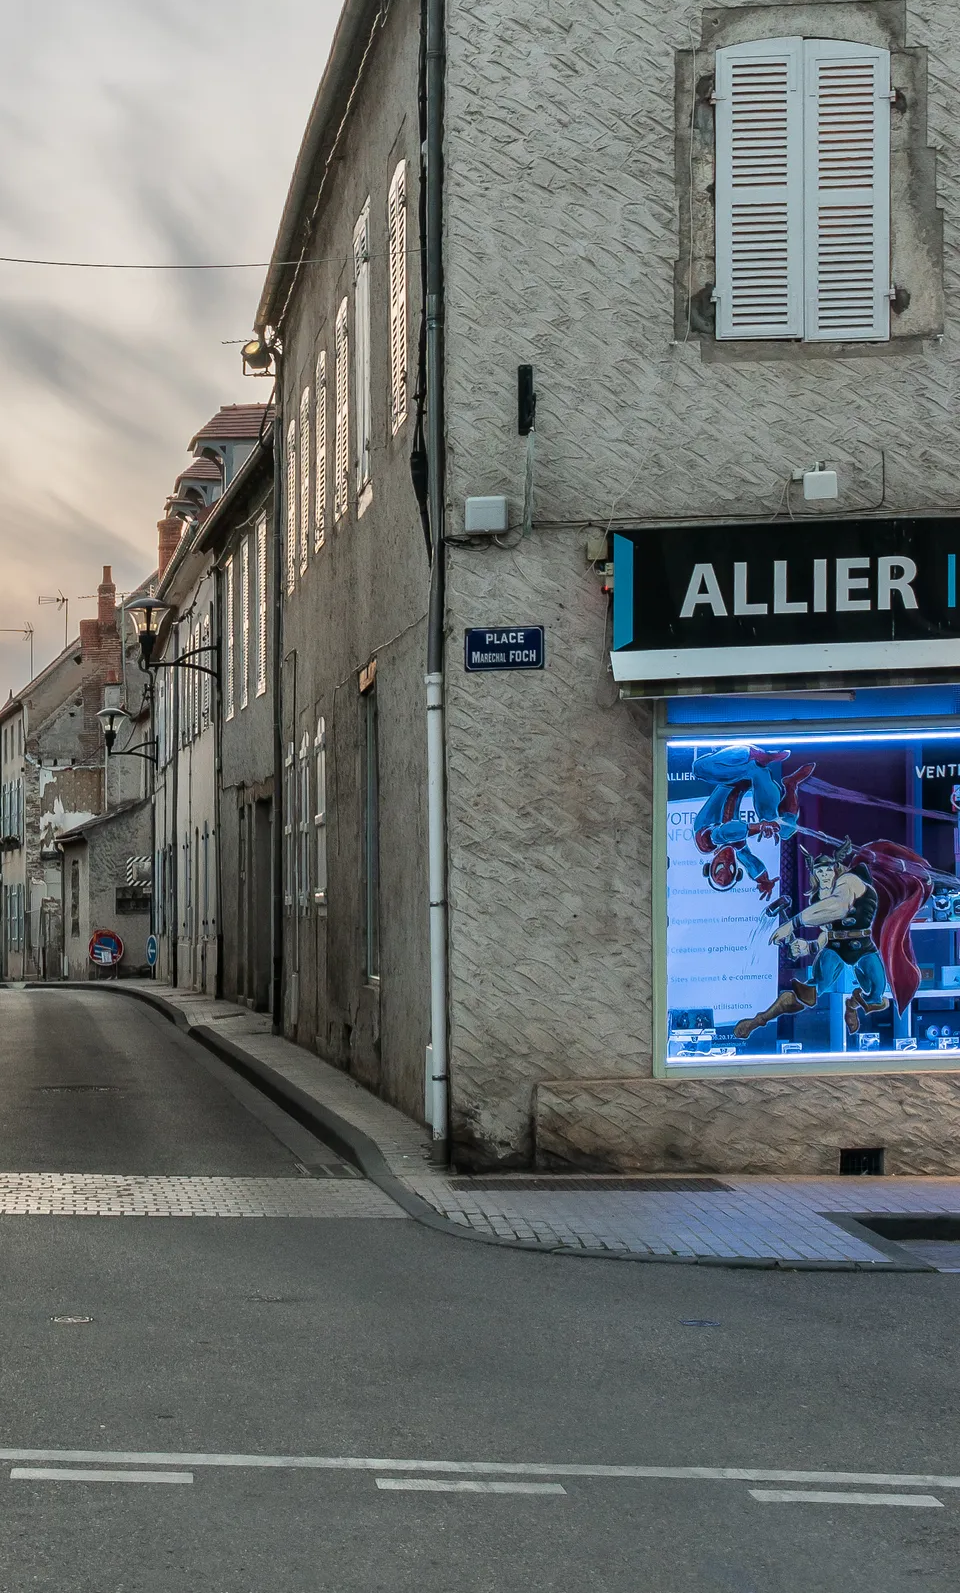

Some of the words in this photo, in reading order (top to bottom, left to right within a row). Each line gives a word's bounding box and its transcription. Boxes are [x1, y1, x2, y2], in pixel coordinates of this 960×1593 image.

[680, 556, 919, 617] ALLIER
[485, 632, 525, 645] PLACE
[509, 649, 537, 663] FOCH
[915, 763, 960, 779] VENT
[707, 944, 748, 954] graphiques
[670, 975, 688, 983] Sites
[728, 973, 773, 981] e-commerce
[713, 1003, 753, 1011] utilisations
